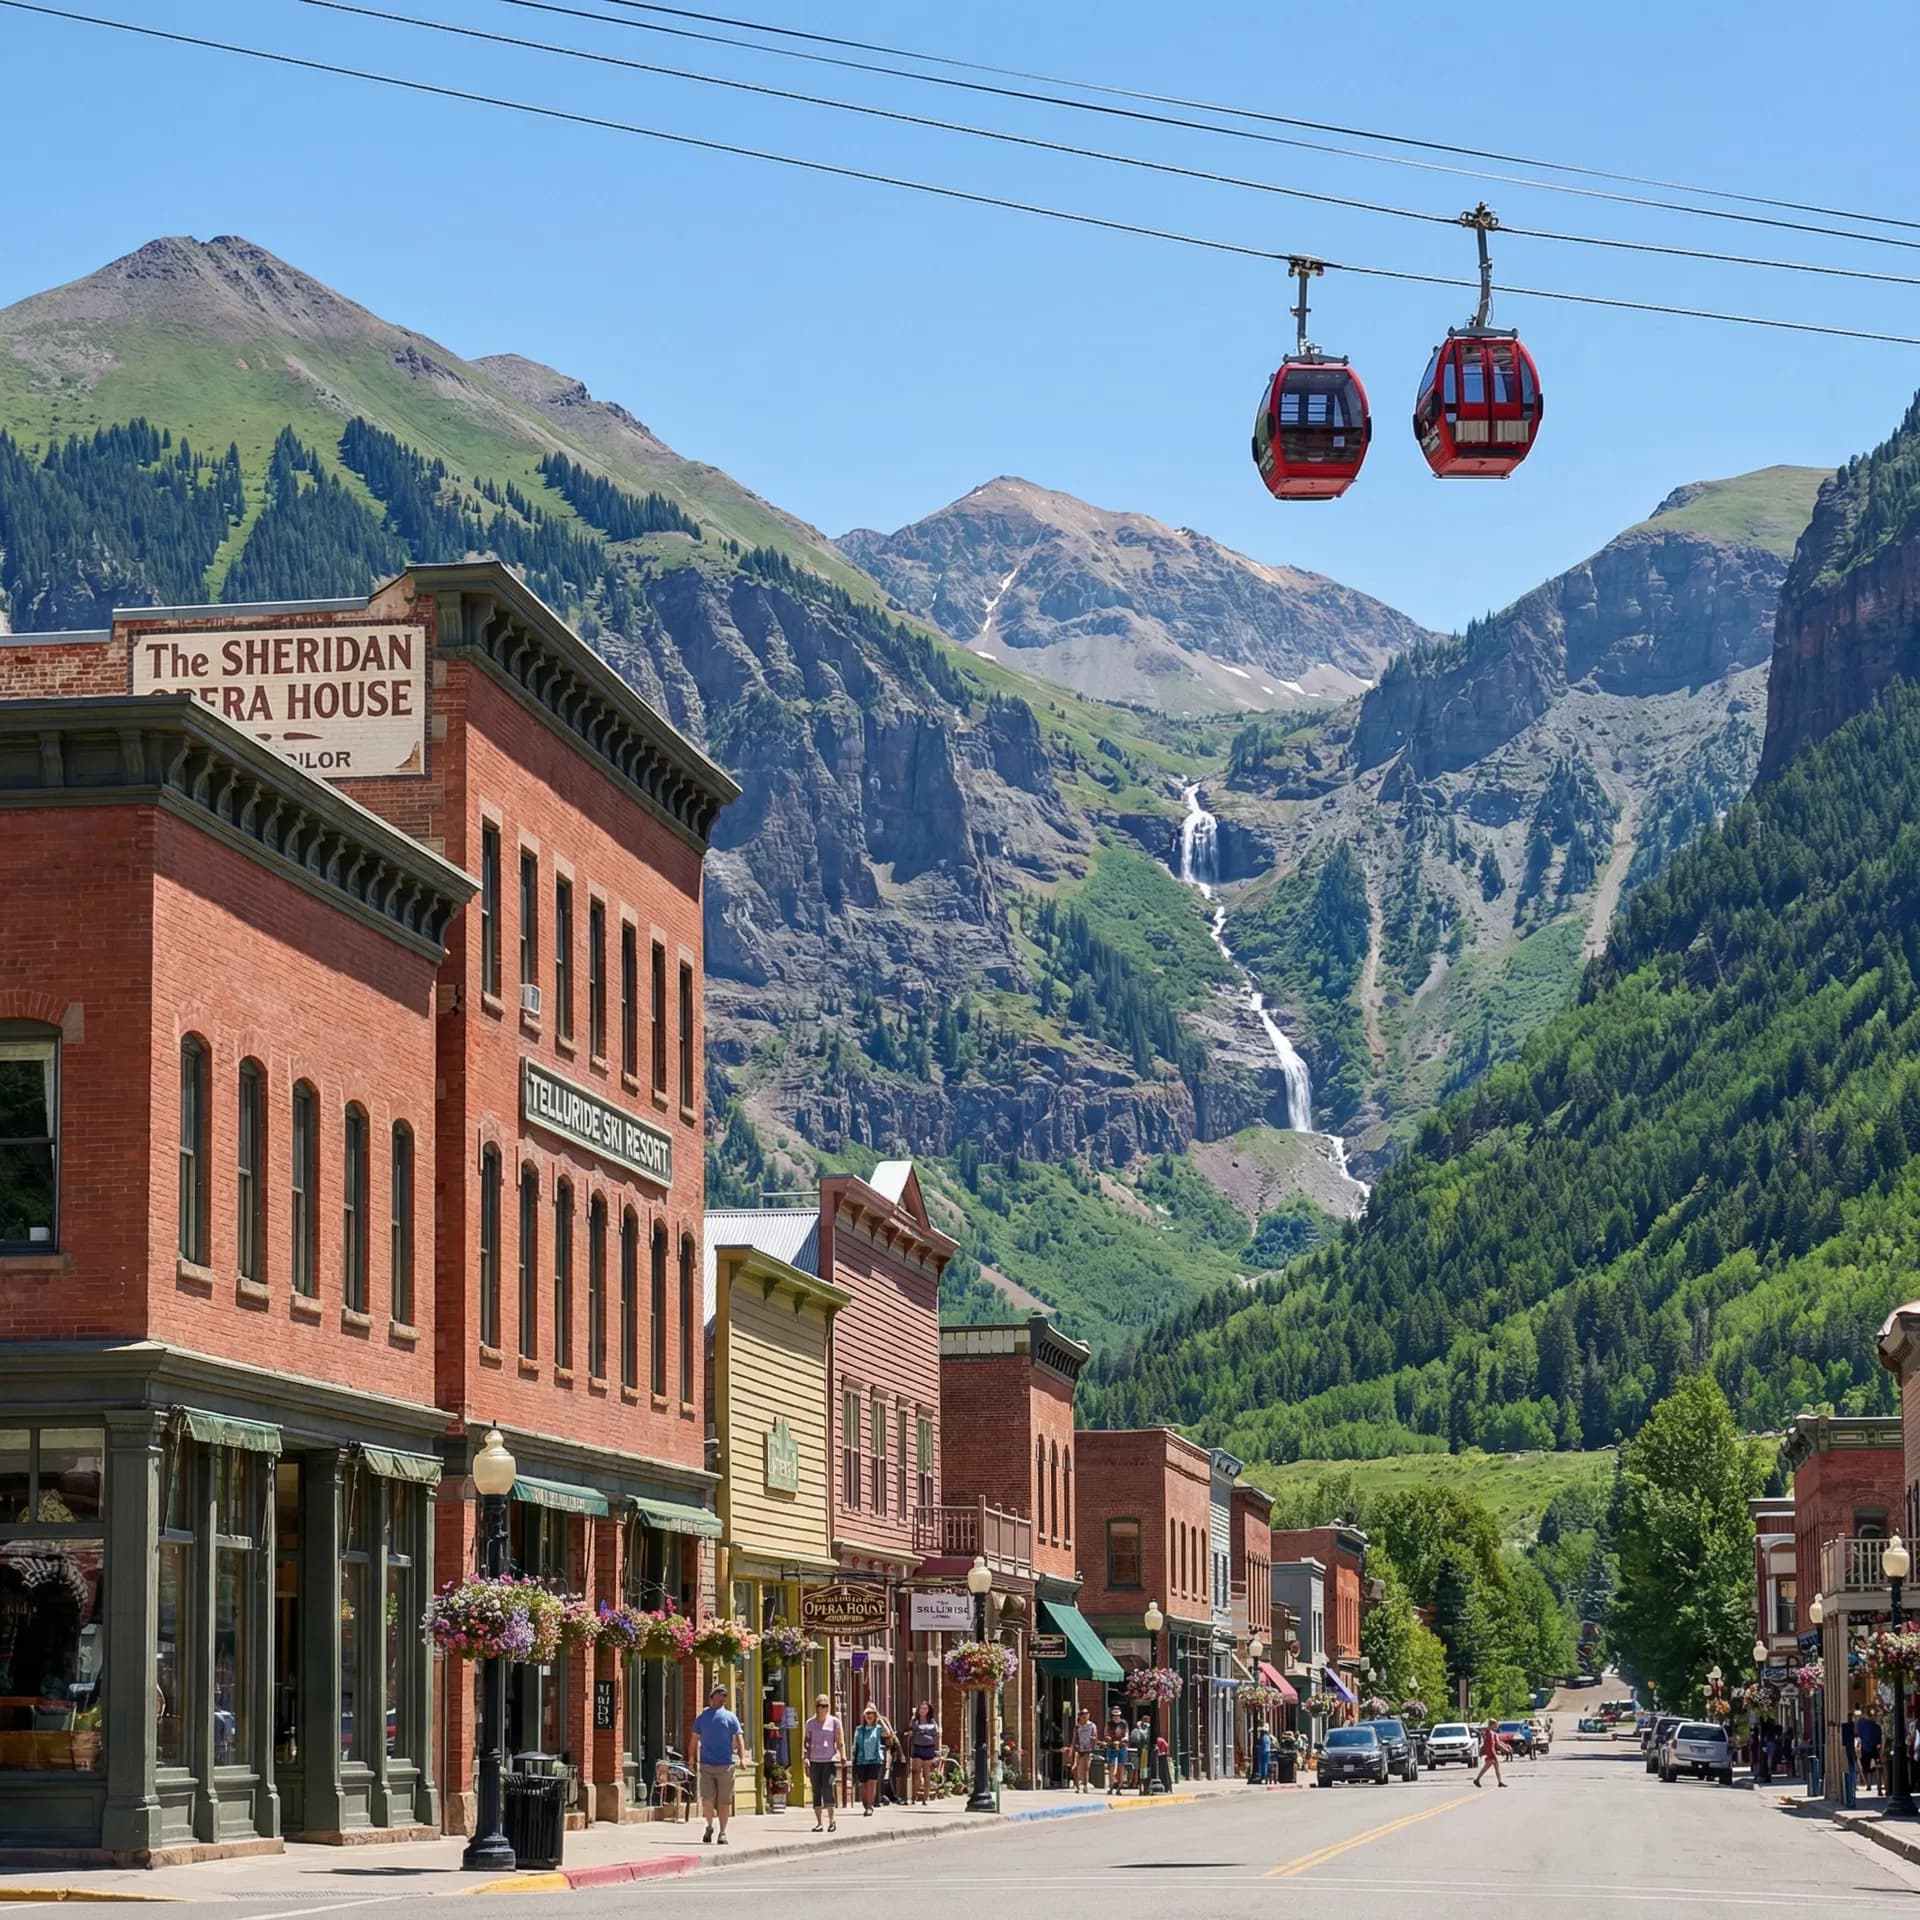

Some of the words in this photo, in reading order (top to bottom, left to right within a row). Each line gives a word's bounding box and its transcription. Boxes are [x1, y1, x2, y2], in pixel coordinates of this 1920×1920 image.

[146, 643, 209, 678] The
[222, 634, 412, 676] SHERIDAN
[150, 685, 273, 722] ERA
[287, 680, 412, 720] HOUSE
[529, 1072, 600, 1141] TELLURIDE
[603, 1111, 623, 1151] SKI
[626, 1122, 669, 1174] RESORT
[804, 1601, 844, 1616] OPERA
[847, 1600, 886, 1615] HOUSE
